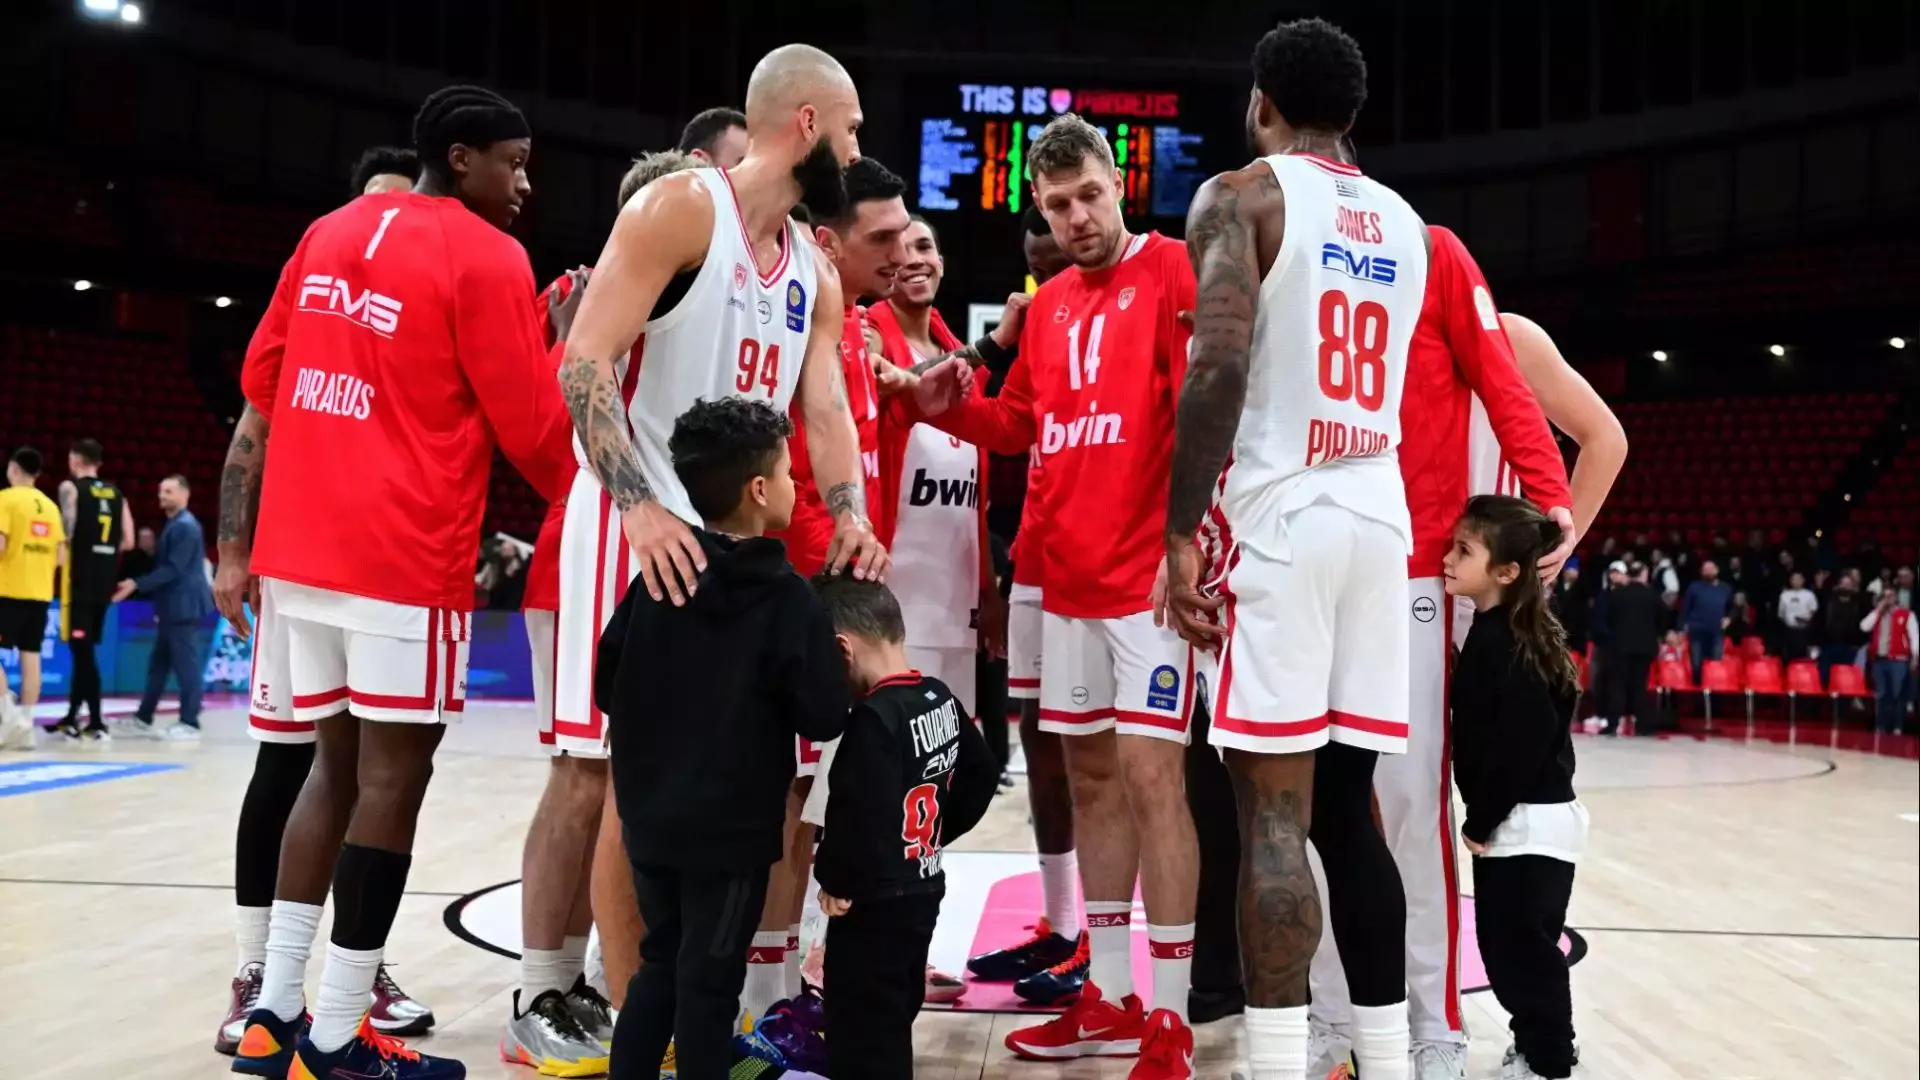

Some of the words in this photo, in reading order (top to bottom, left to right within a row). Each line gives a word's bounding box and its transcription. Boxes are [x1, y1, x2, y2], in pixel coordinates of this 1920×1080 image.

[959, 84, 1015, 114] THIS
[1022, 86, 1048, 115] IS
[364, 208, 400, 260] 1
[1335, 204, 1383, 245] JONES
[299, 274, 403, 335] FMS
[735, 337, 780, 399] 94
[1066, 313, 1106, 391] 14
[1318, 289, 1390, 412] 88
[291, 367, 376, 421] PIRAEUS
[98, 515, 113, 544] 7
[909, 697, 960, 758] FOURNIE
[902, 782, 944, 861] 9
[1175, 945, 1194, 957] GS
